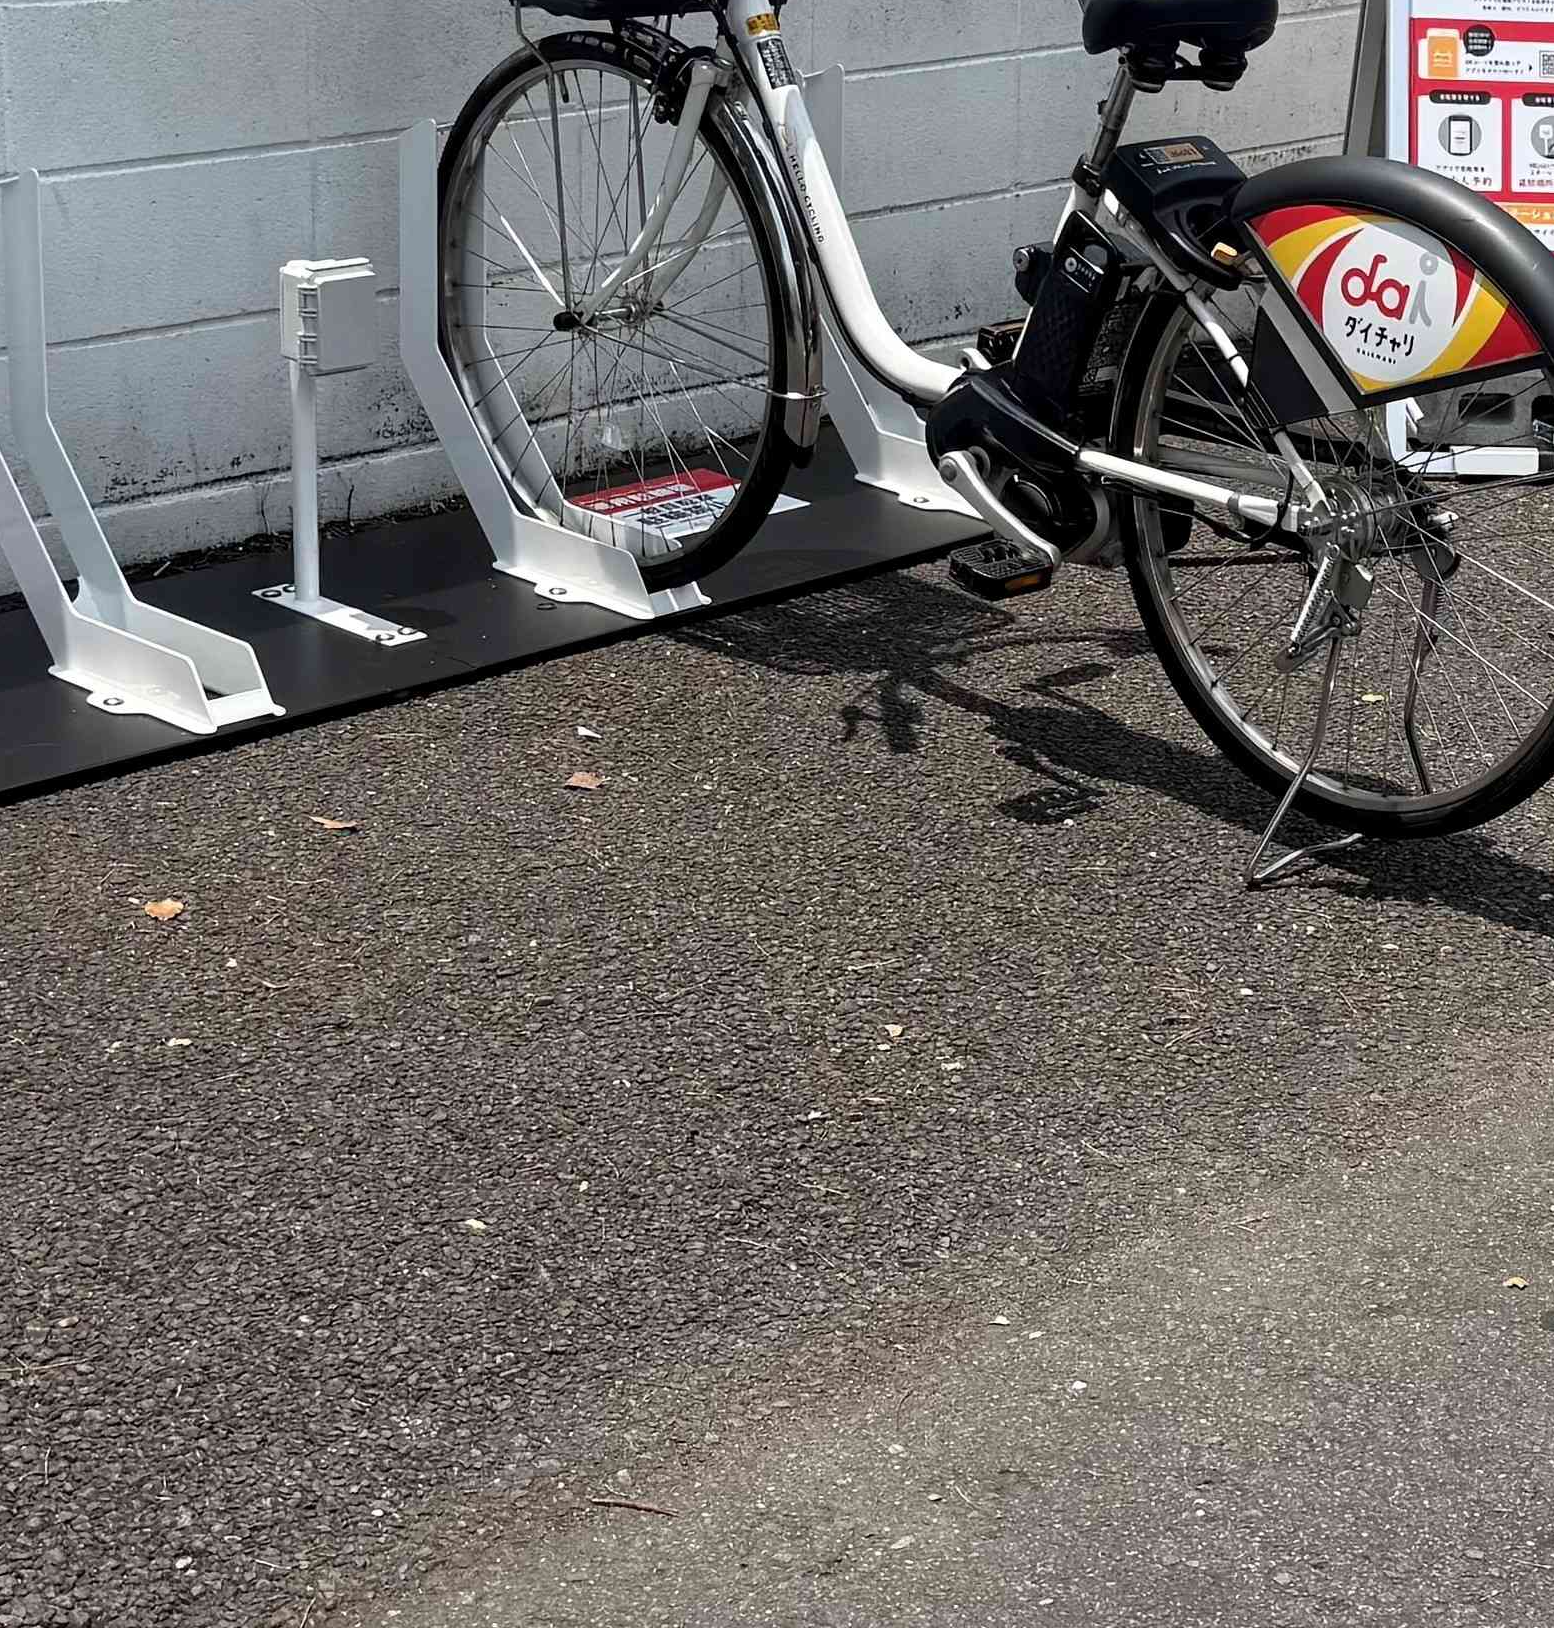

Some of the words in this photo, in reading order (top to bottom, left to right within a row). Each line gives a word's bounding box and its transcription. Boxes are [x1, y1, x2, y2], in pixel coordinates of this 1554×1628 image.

[789, 154, 807, 194] HELLO
[1340, 252, 1439, 328] dai
[1344, 315, 1415, 357] ダイチャリ
